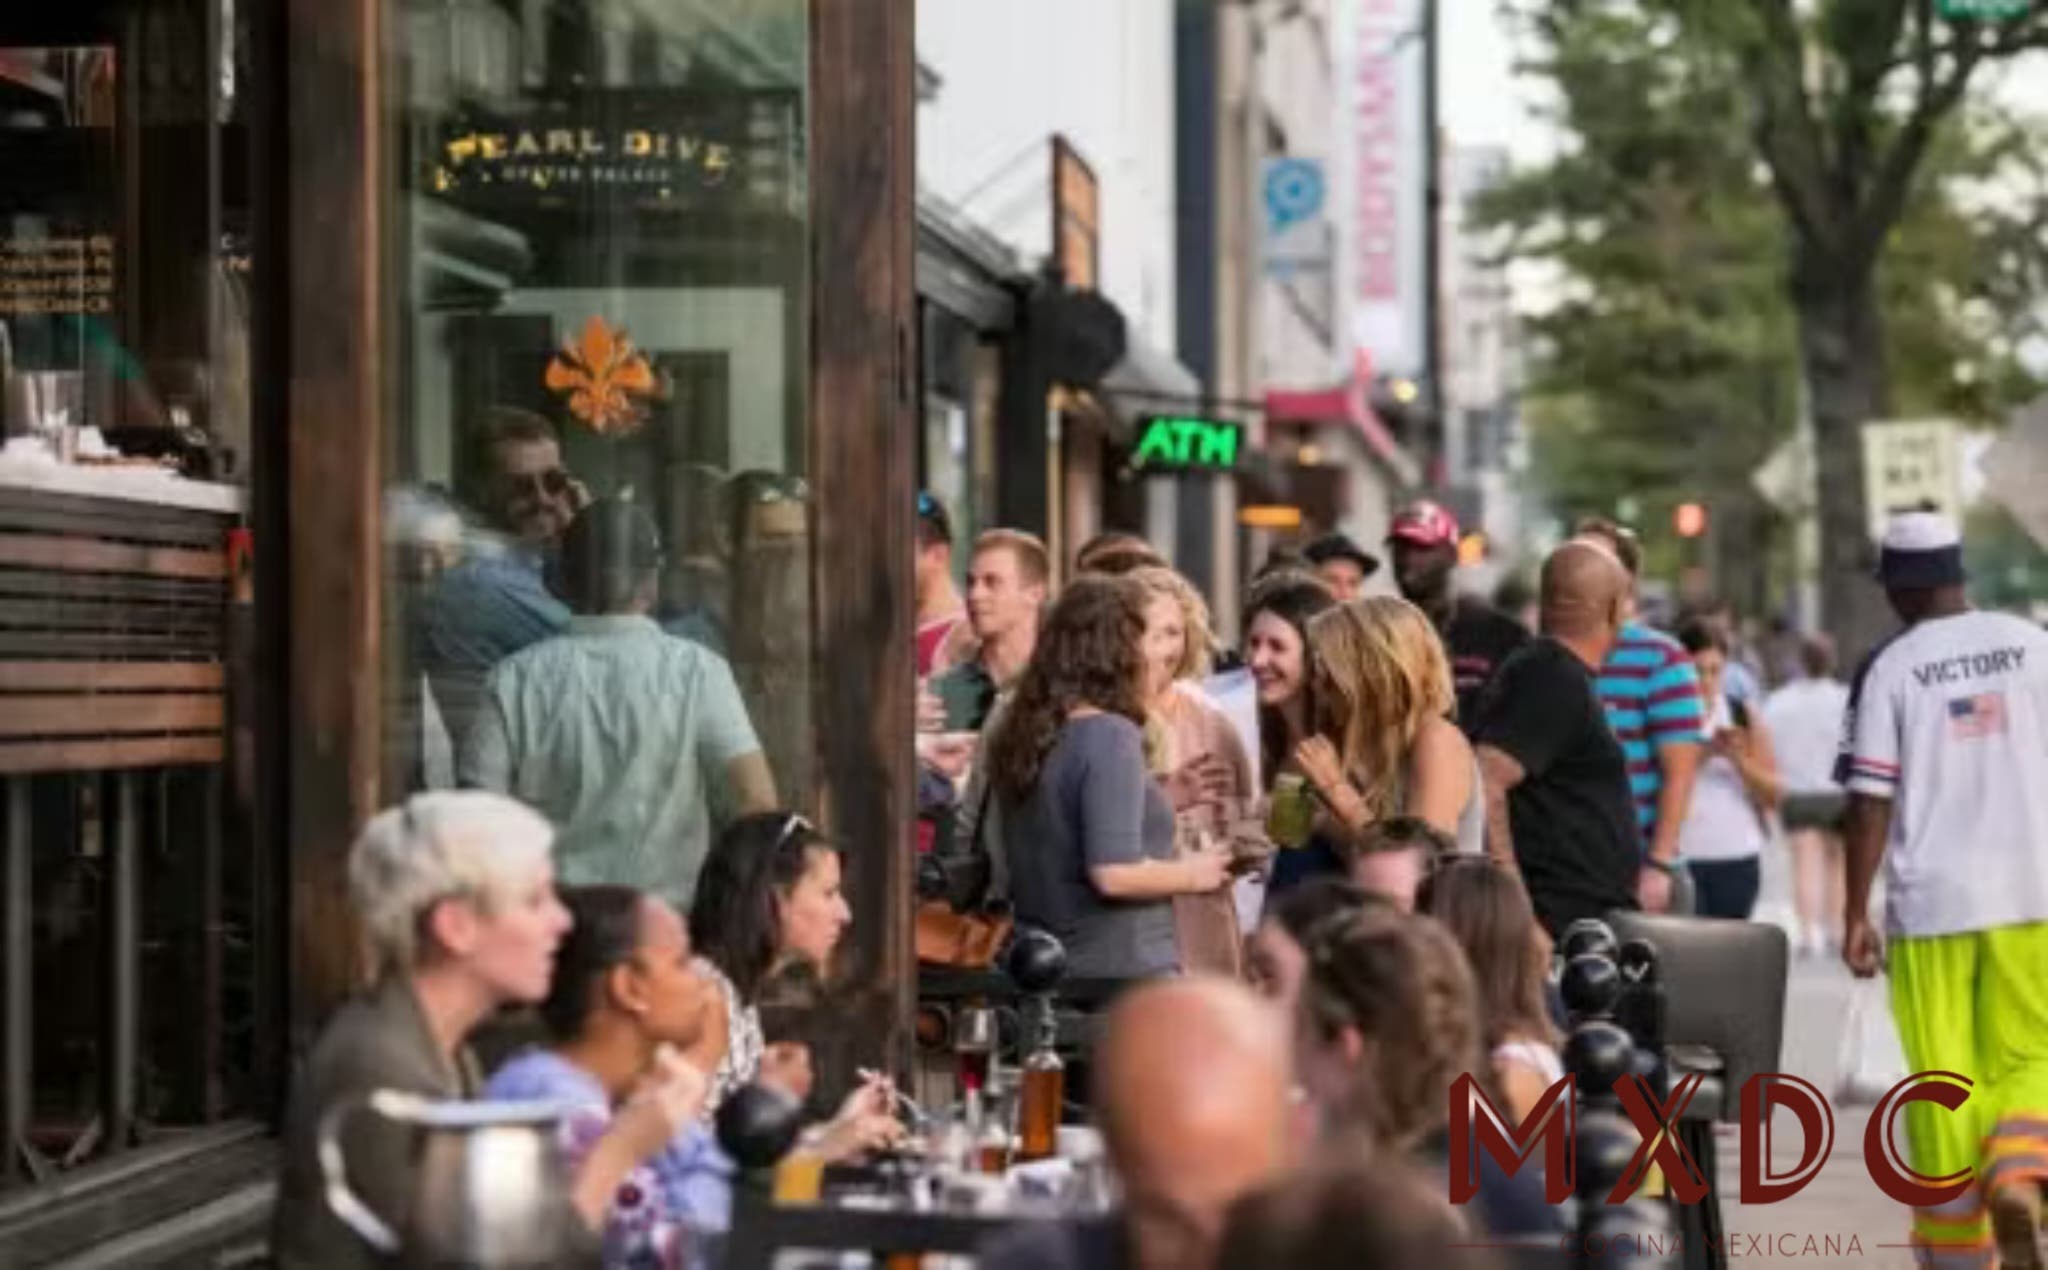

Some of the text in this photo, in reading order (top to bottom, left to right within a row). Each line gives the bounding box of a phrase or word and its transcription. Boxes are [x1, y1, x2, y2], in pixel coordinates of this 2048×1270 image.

[446, 128, 731, 168] PEARL DIVE
[1138, 417, 1237, 466] ATM
[1912, 645, 2025, 688] VICTORY
